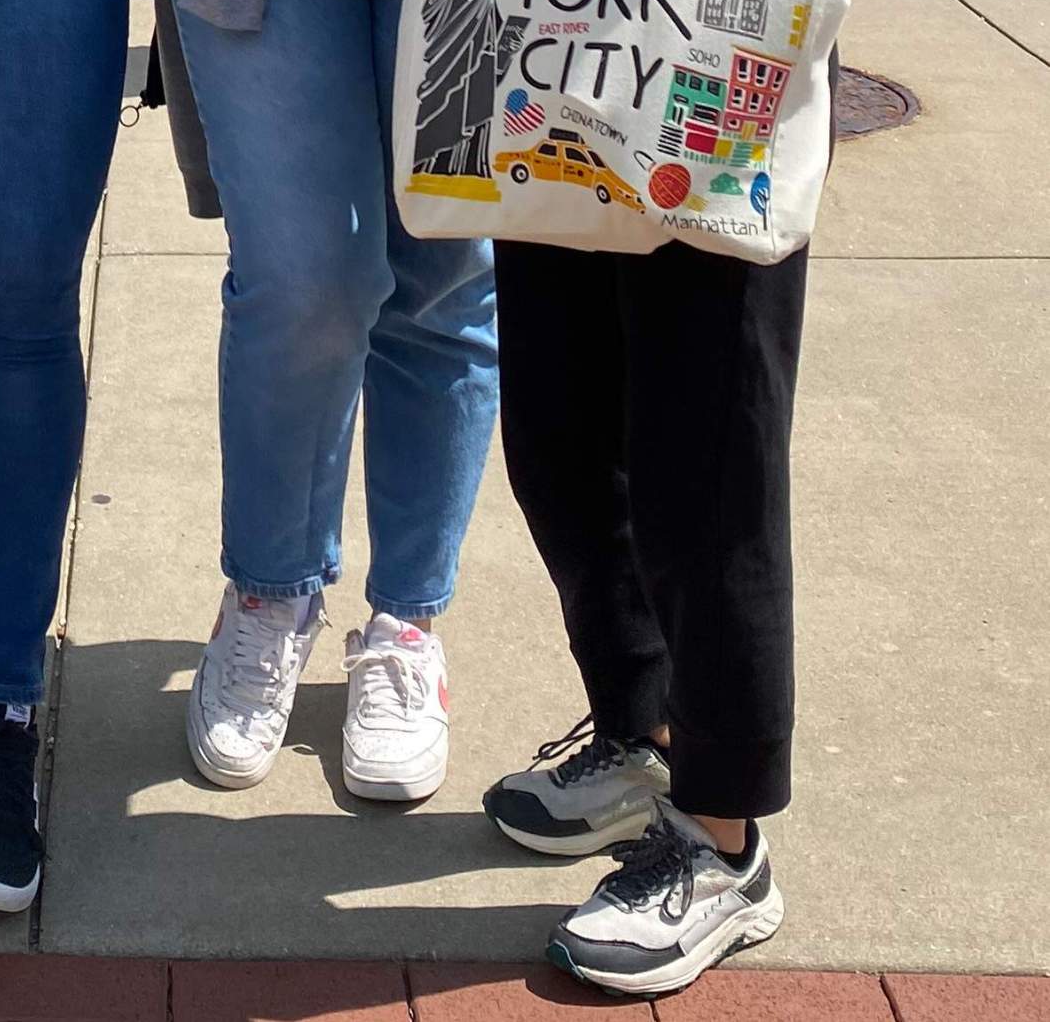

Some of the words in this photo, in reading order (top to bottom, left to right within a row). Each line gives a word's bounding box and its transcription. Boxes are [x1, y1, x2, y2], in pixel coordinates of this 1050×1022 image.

[538, 22, 561, 35] EAST
[562, 22, 590, 35] RIVER
[688, 47, 721, 68] SOHO
[519, 37, 665, 110] CITY
[560, 104, 629, 148] CHINATOWN
[660, 211, 758, 237] Manhattan
